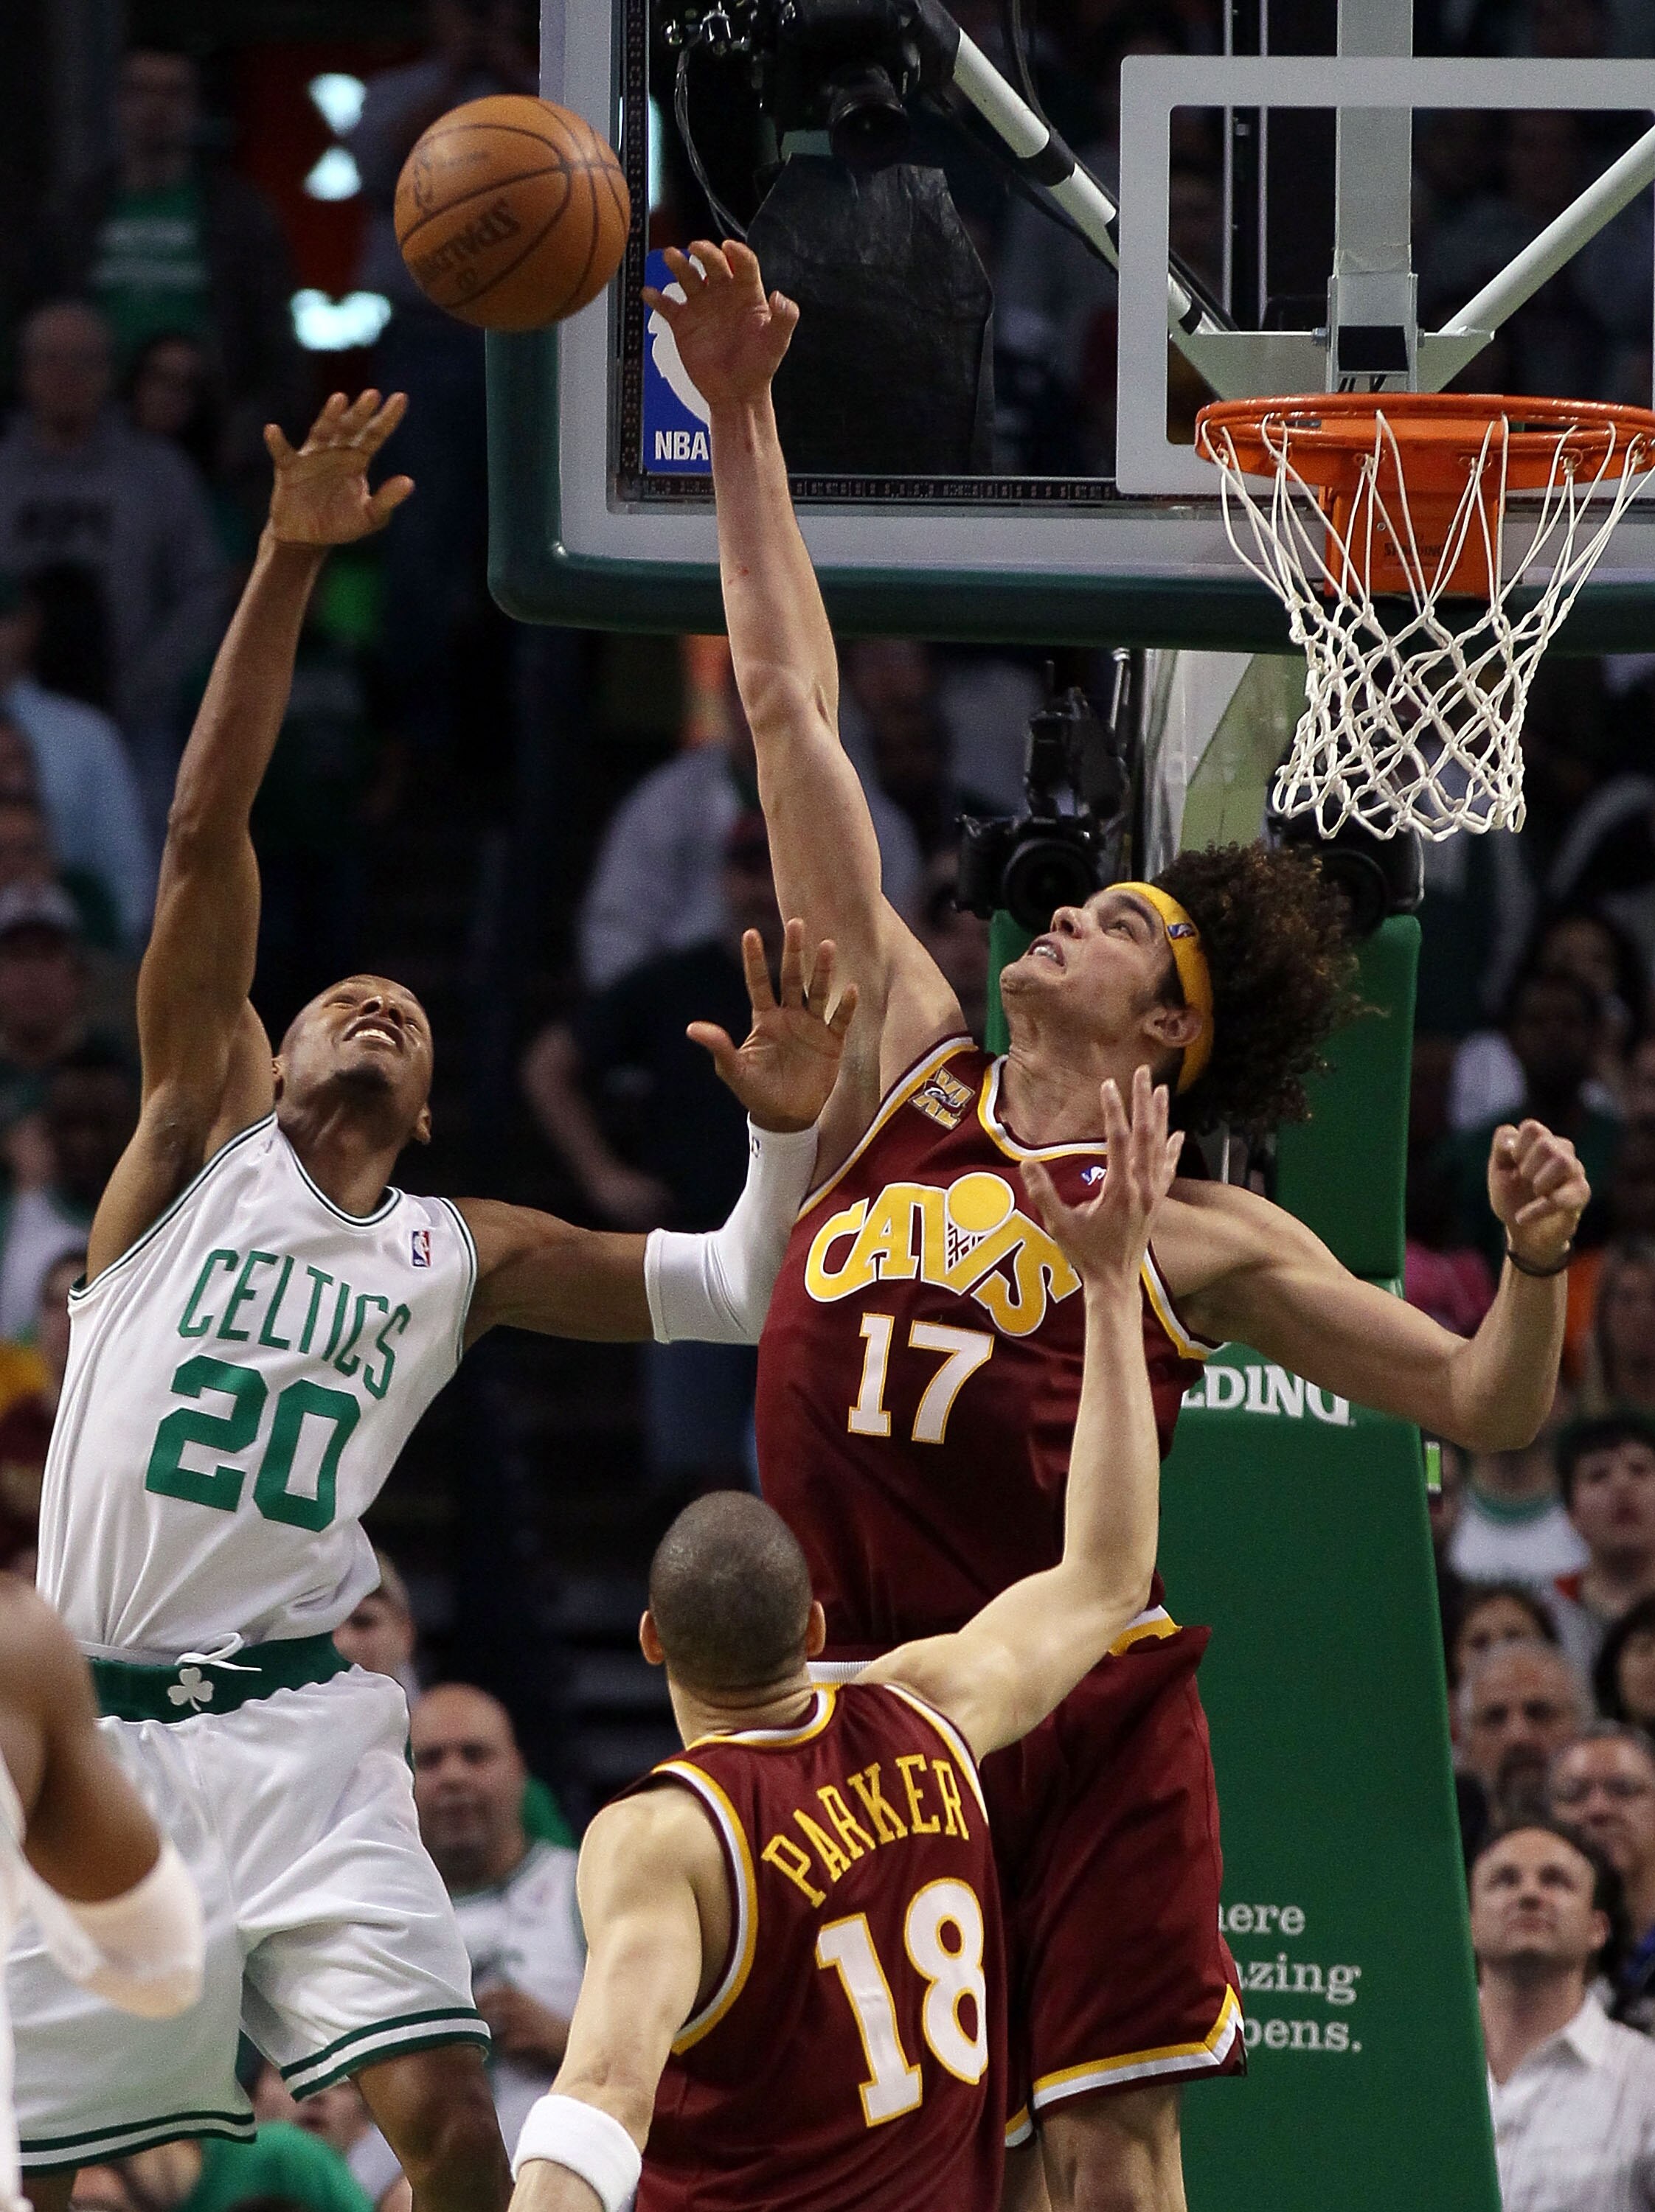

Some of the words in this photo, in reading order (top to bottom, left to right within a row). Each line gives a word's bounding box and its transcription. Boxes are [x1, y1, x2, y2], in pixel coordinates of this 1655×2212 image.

[655, 430, 709, 461] NBA
[179, 1249, 412, 1400] CELTICS
[805, 1172, 1082, 1337] CAVS
[147, 1354, 361, 1533] 20
[848, 1312, 994, 1444] 17
[761, 1753, 969, 1908] PARKER
[815, 1877, 989, 2128] 18
